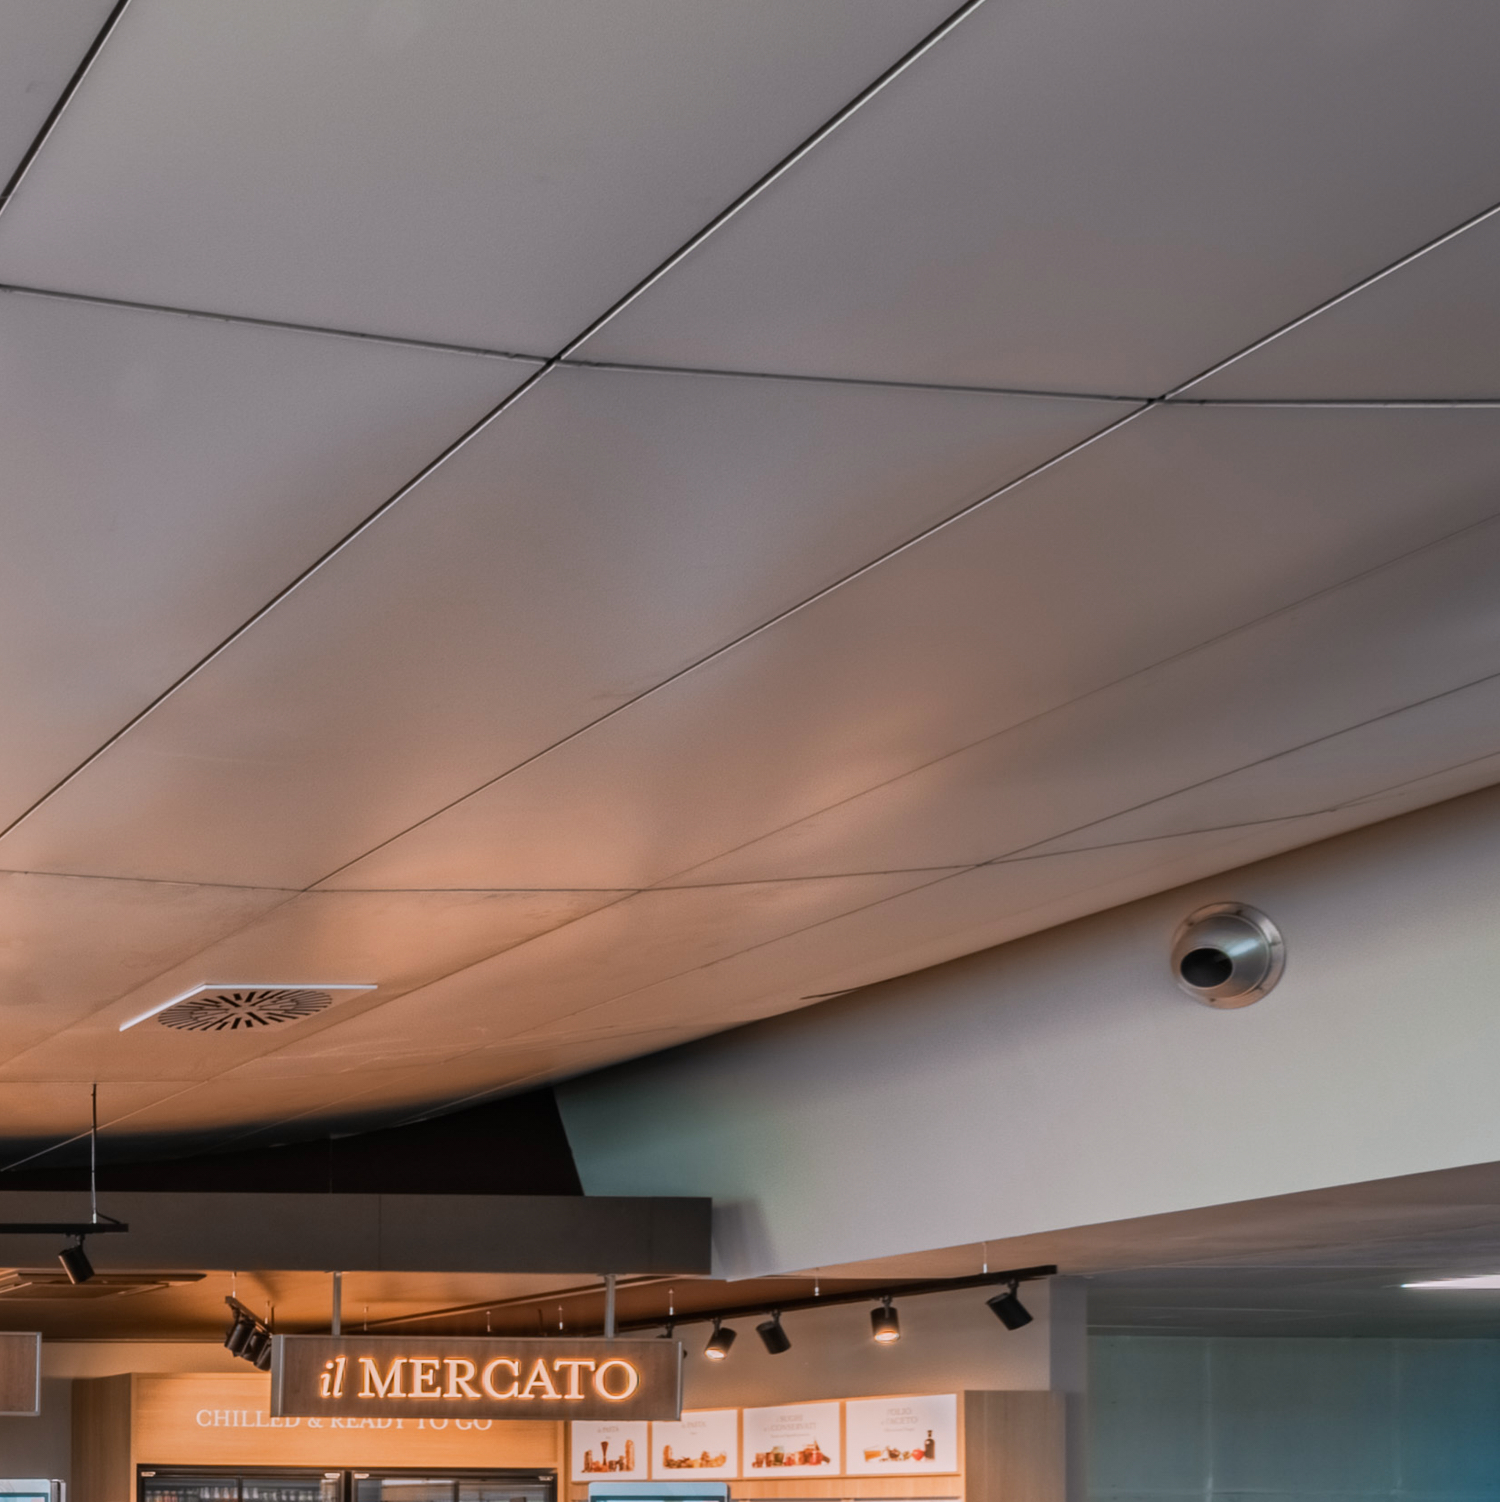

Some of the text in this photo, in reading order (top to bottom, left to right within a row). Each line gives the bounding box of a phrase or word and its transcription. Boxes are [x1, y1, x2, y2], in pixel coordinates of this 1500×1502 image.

[320, 1355, 639, 1400] il MERCATO
[196, 1409, 300, 1428] CHILLED
